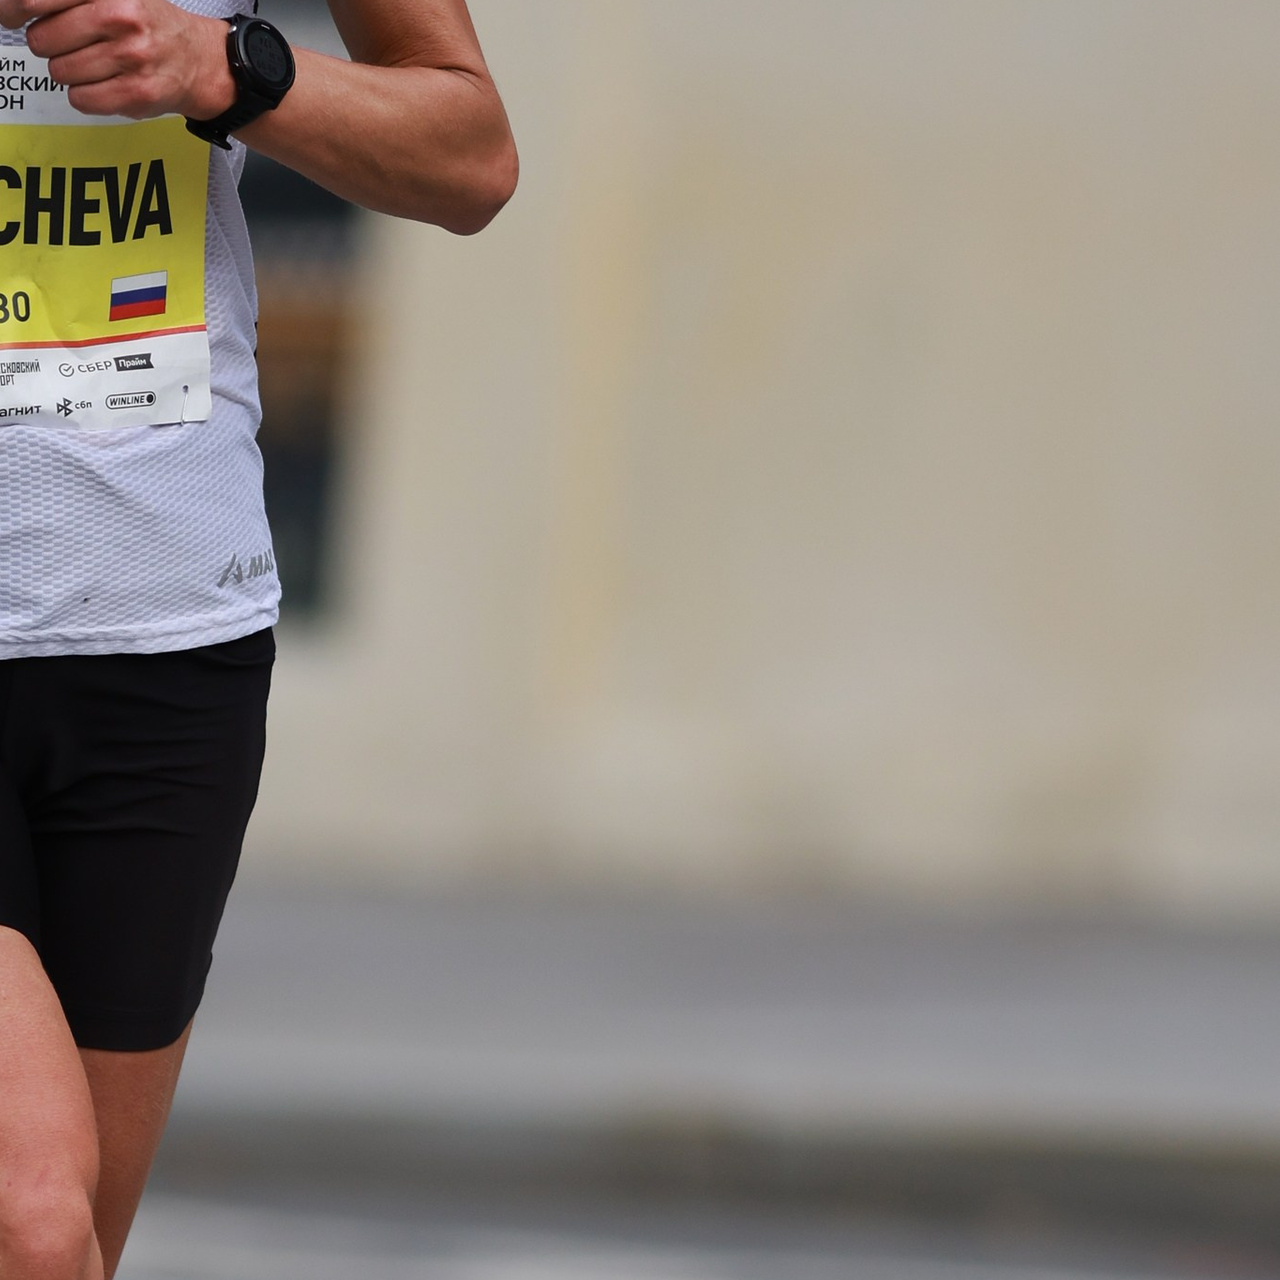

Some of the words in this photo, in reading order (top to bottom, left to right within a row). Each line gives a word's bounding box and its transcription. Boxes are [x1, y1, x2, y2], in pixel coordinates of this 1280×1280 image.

[77, 360, 113, 373] СБЕР
[118, 356, 147, 368] Прайм
[109, 395, 145, 407] WINLINE
